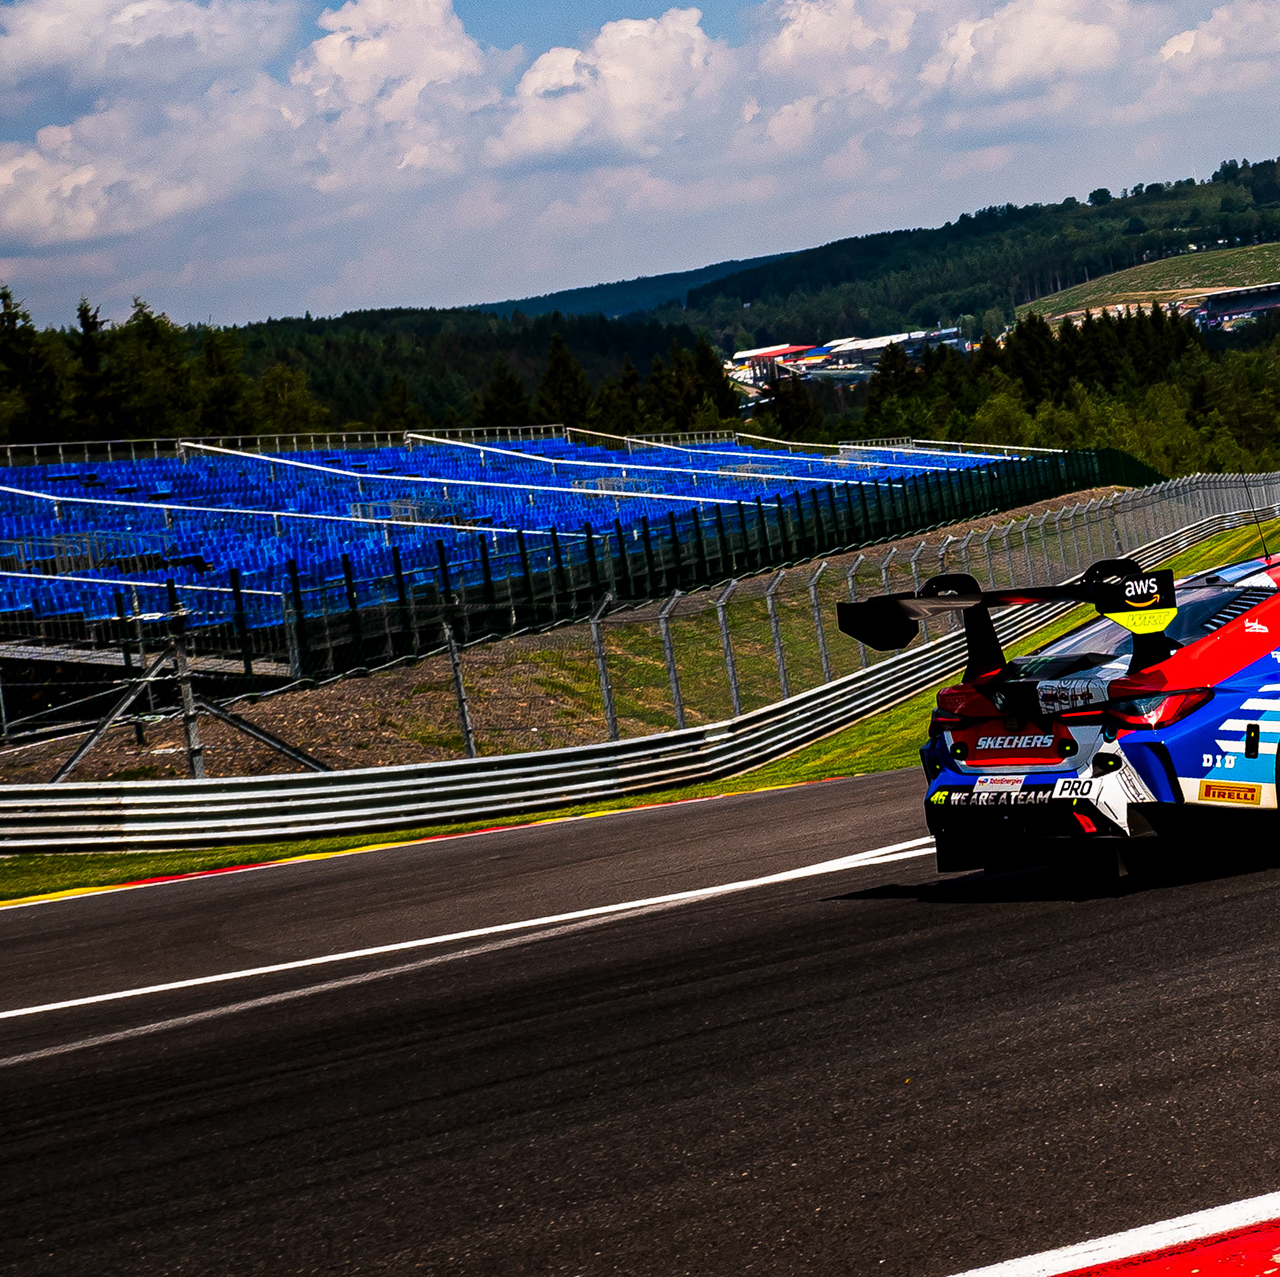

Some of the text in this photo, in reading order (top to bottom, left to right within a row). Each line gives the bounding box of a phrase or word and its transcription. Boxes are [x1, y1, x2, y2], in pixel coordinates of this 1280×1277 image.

[1125, 578, 1158, 597] aws
[1126, 611, 1170, 627] WRT
[976, 735, 1055, 750] SKECHERS
[1059, 780, 1093, 796] PRO
[1204, 784, 1256, 801] PIRELLI
[930, 790, 1052, 806] 46 WE ARE A TEAM
